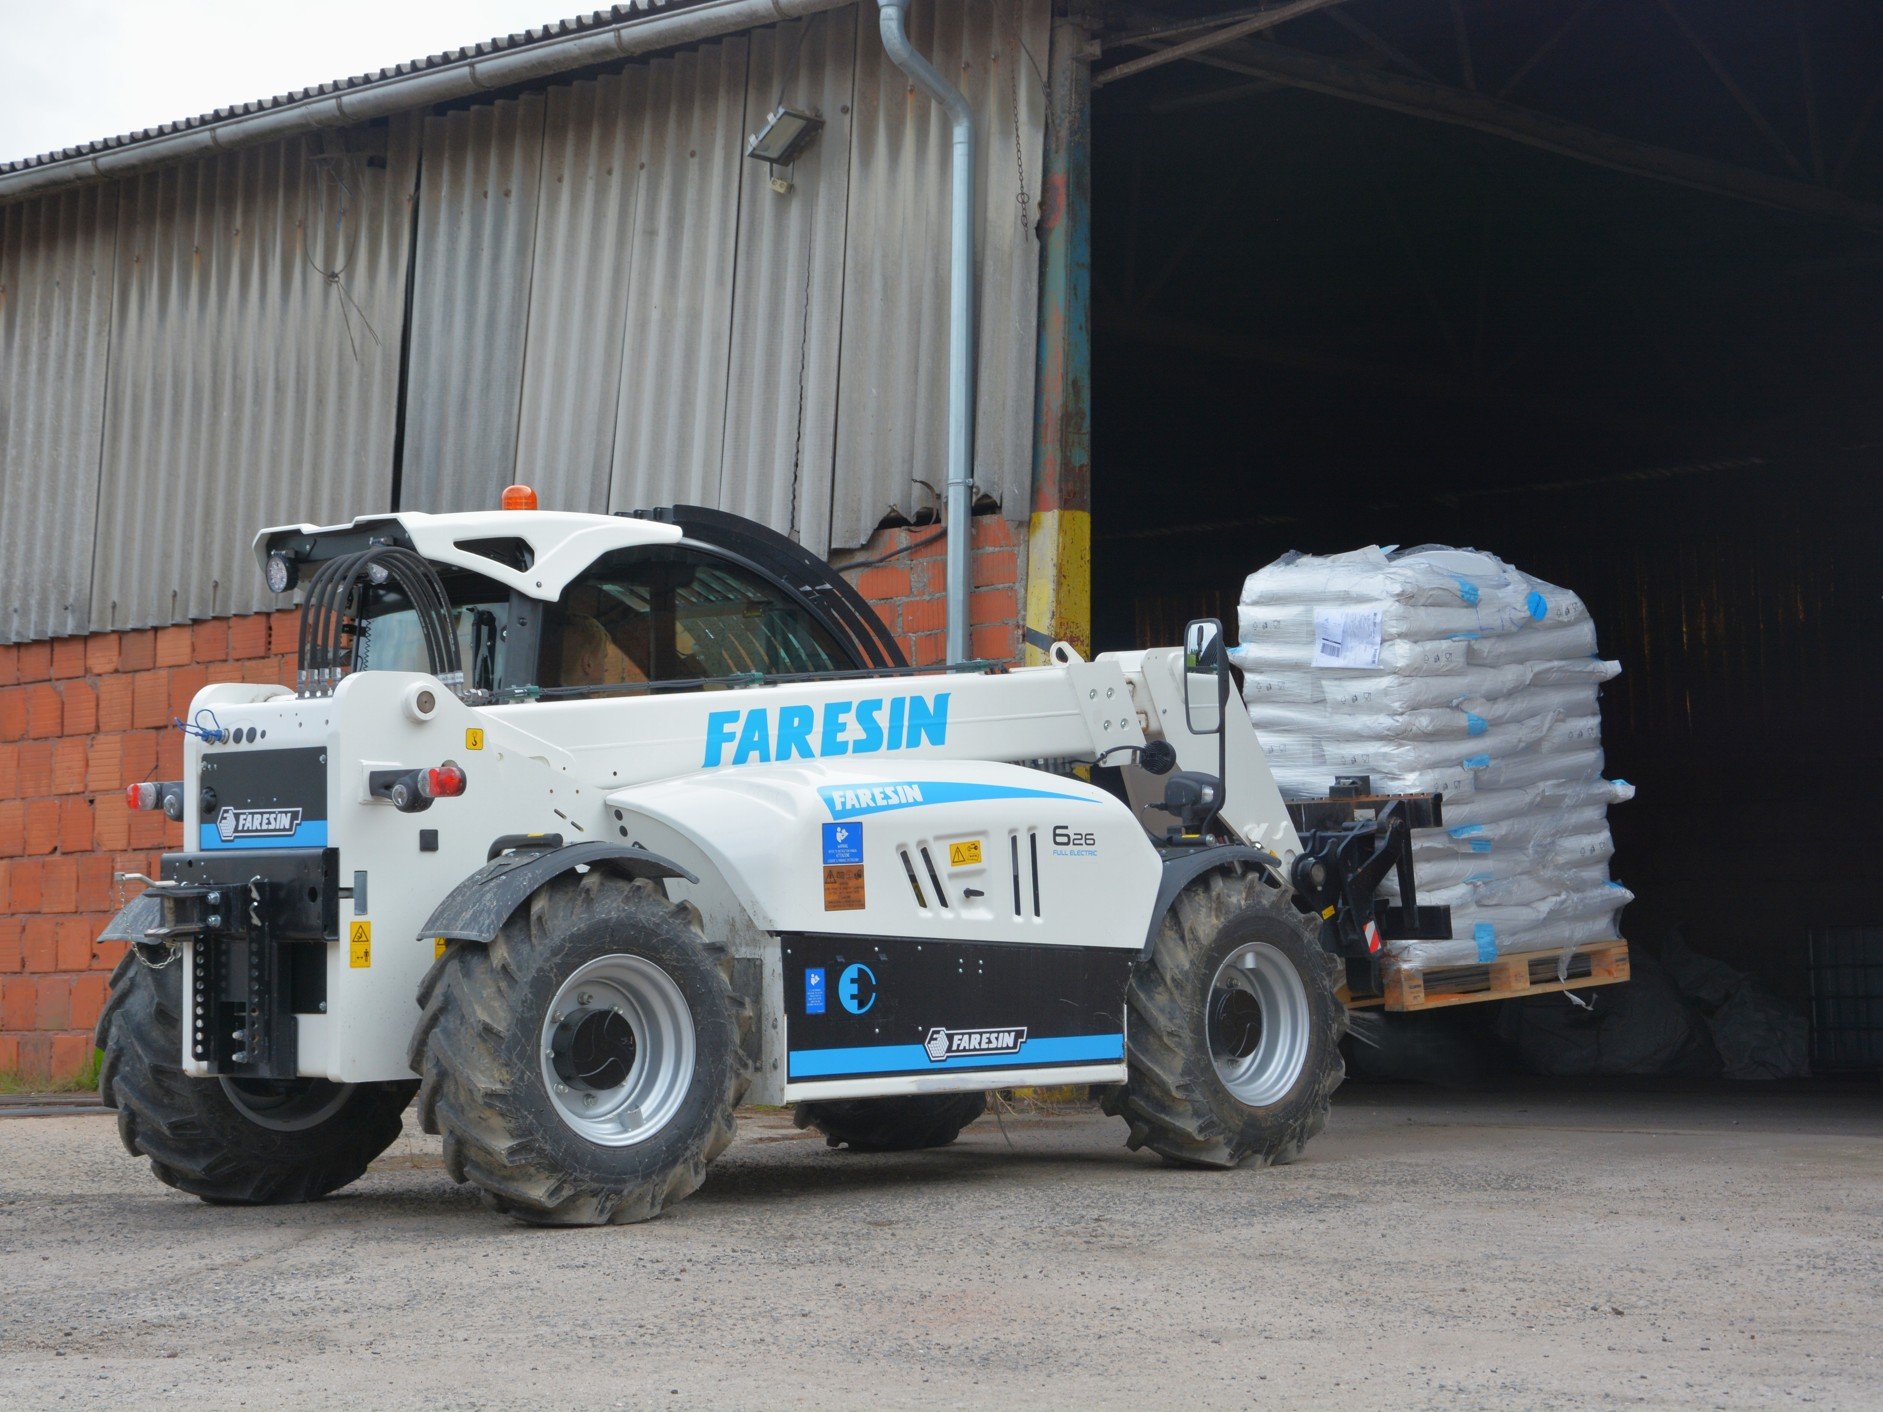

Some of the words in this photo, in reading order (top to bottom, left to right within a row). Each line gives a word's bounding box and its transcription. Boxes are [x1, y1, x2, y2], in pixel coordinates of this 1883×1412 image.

[701, 693, 951, 768] FARESIN
[832, 784, 923, 811] FARESIN
[237, 812, 292, 831] FARESIN
[1053, 825, 1096, 846] 626
[951, 1032, 1015, 1051] FARESIN
